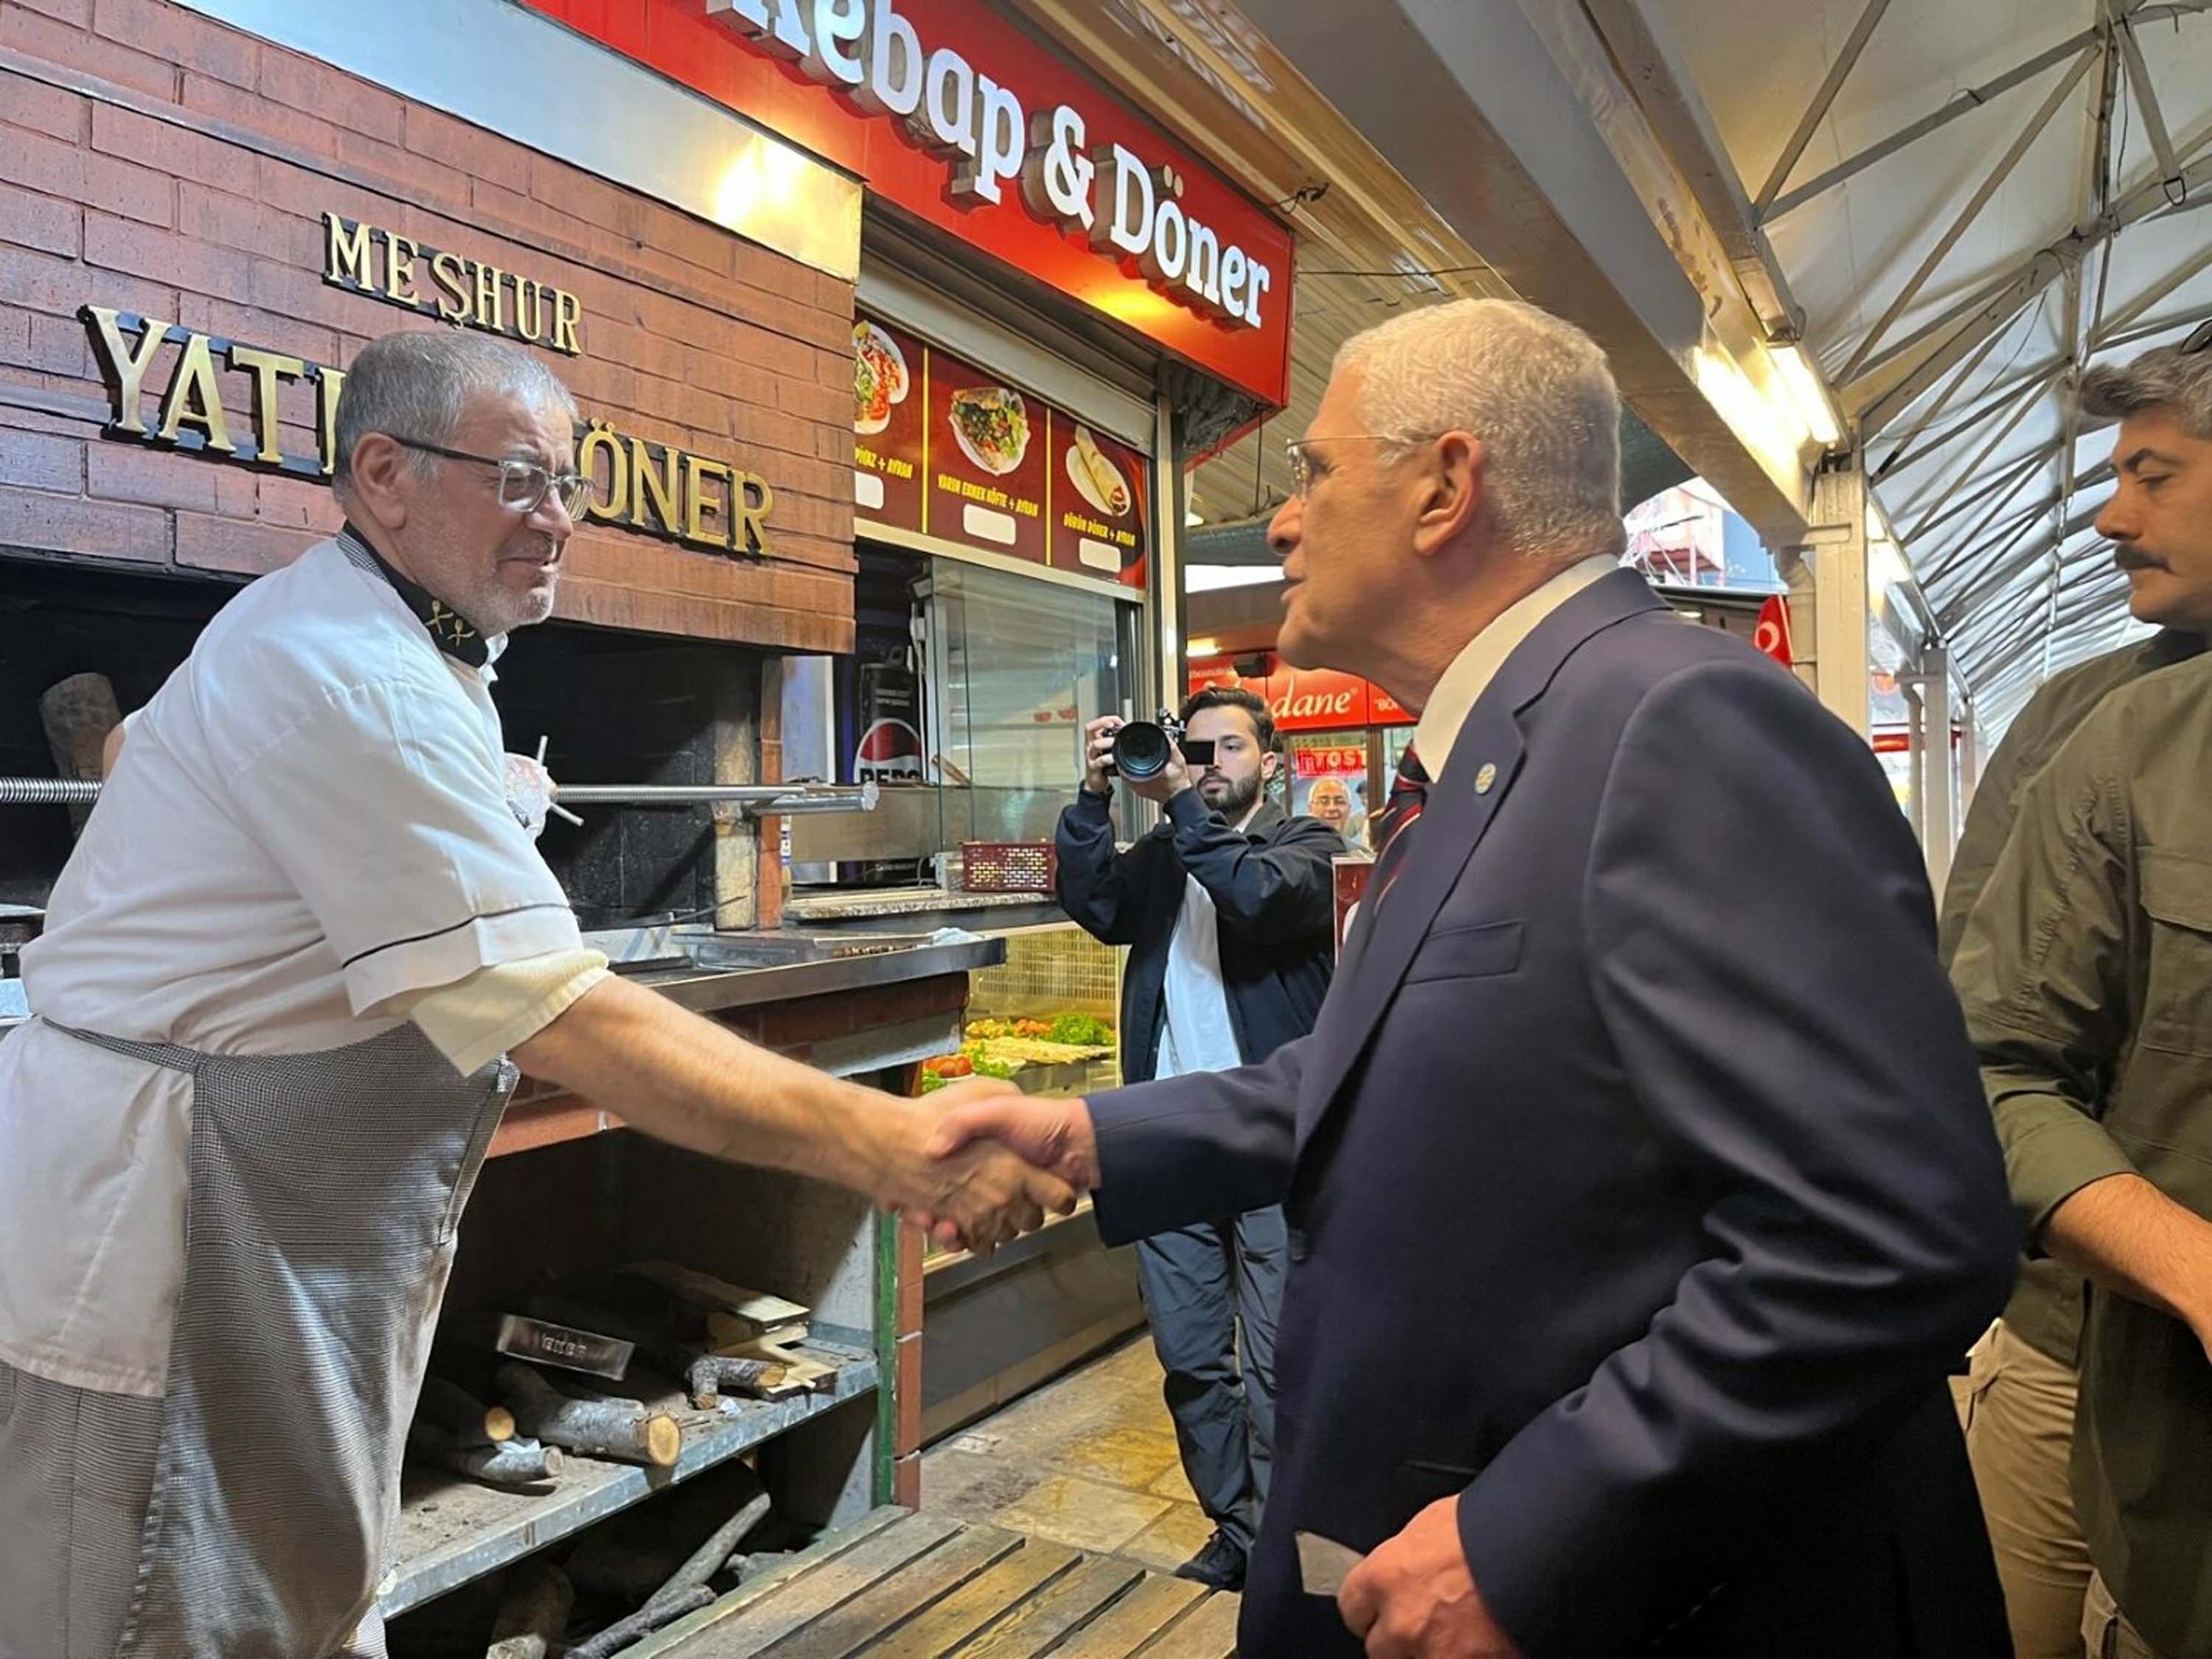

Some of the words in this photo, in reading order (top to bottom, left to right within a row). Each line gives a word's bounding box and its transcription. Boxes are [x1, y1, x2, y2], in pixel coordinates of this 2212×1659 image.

[323, 212, 582, 356] MEŞHUR
[1044, 105, 1095, 231] &
[1110, 142, 1270, 329] Döner
[78, 305, 346, 476] YATI
[580, 416, 776, 557] ÖNER
